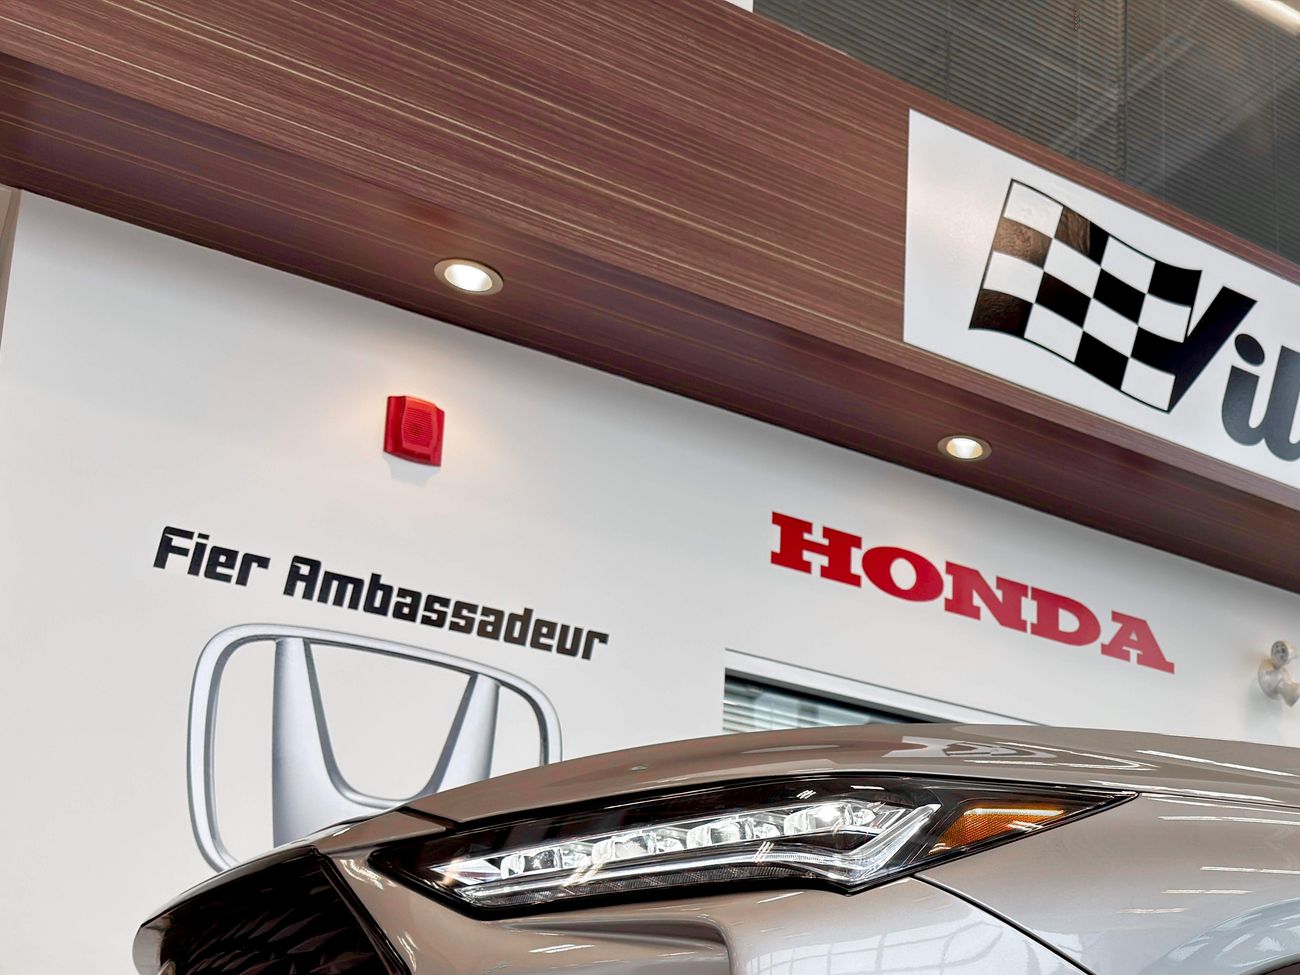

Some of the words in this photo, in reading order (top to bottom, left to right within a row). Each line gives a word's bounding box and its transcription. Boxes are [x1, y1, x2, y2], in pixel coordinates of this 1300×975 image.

[153, 525, 271, 587] Fier
[283, 555, 610, 661] Ambassadeur
[770, 511, 1176, 675] HONDA
